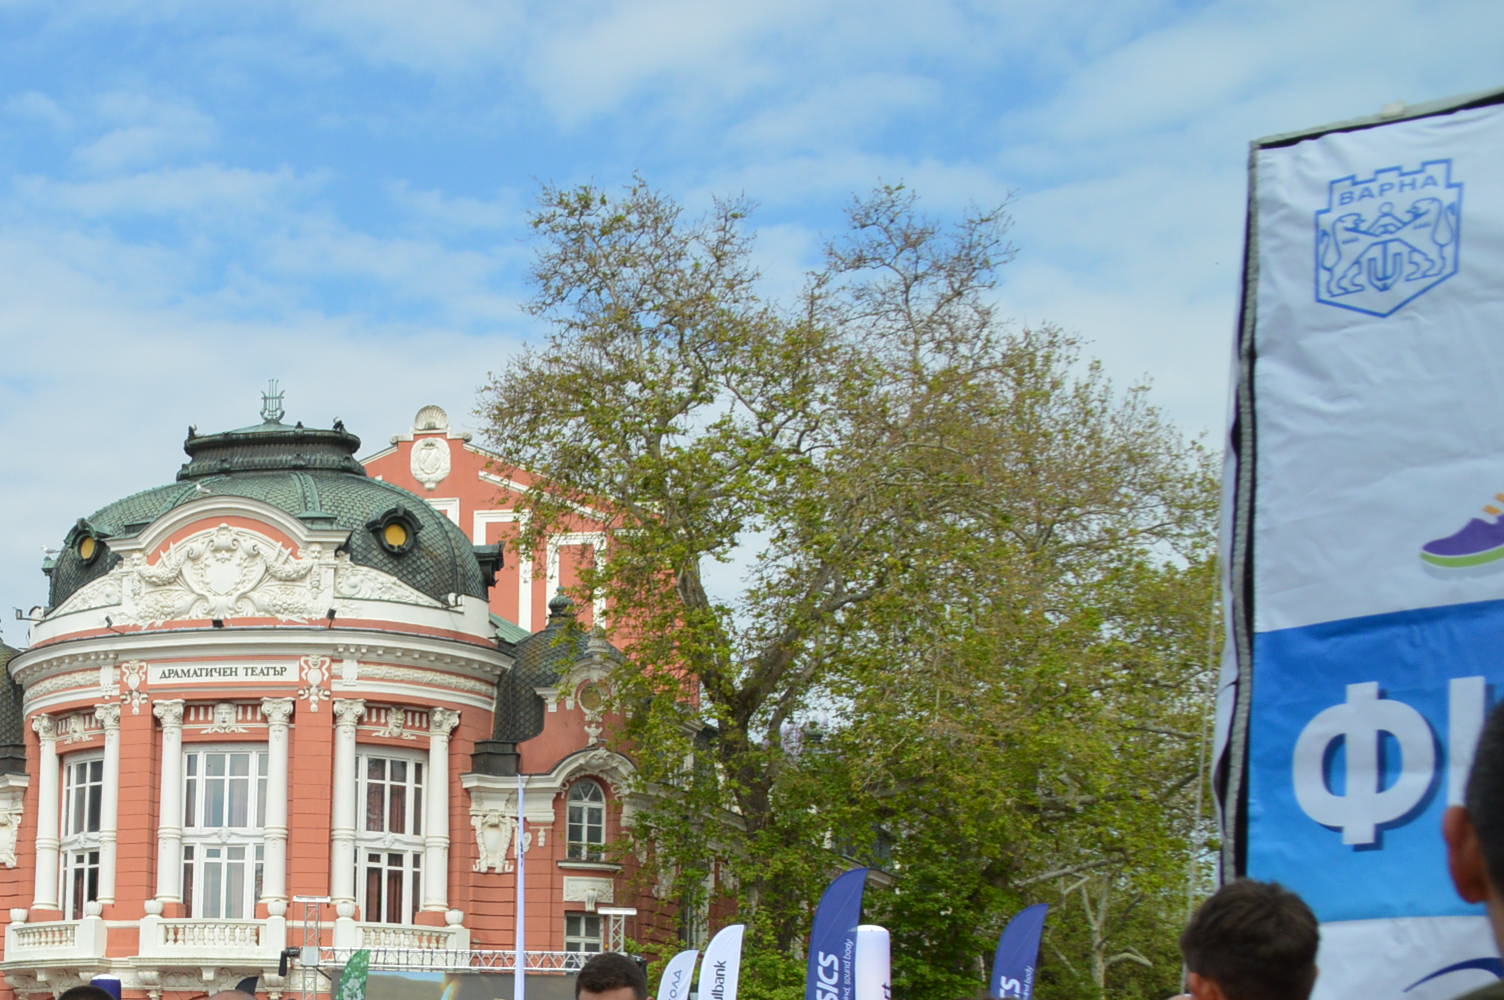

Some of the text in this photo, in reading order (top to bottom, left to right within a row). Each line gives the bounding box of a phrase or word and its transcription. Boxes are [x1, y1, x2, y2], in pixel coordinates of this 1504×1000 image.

[1339, 174, 1437, 206] ВАРНА
[159, 666, 288, 679] ДРАМАТИЧЕН ТЕАТЪР
[843, 938, 854, 960] body
